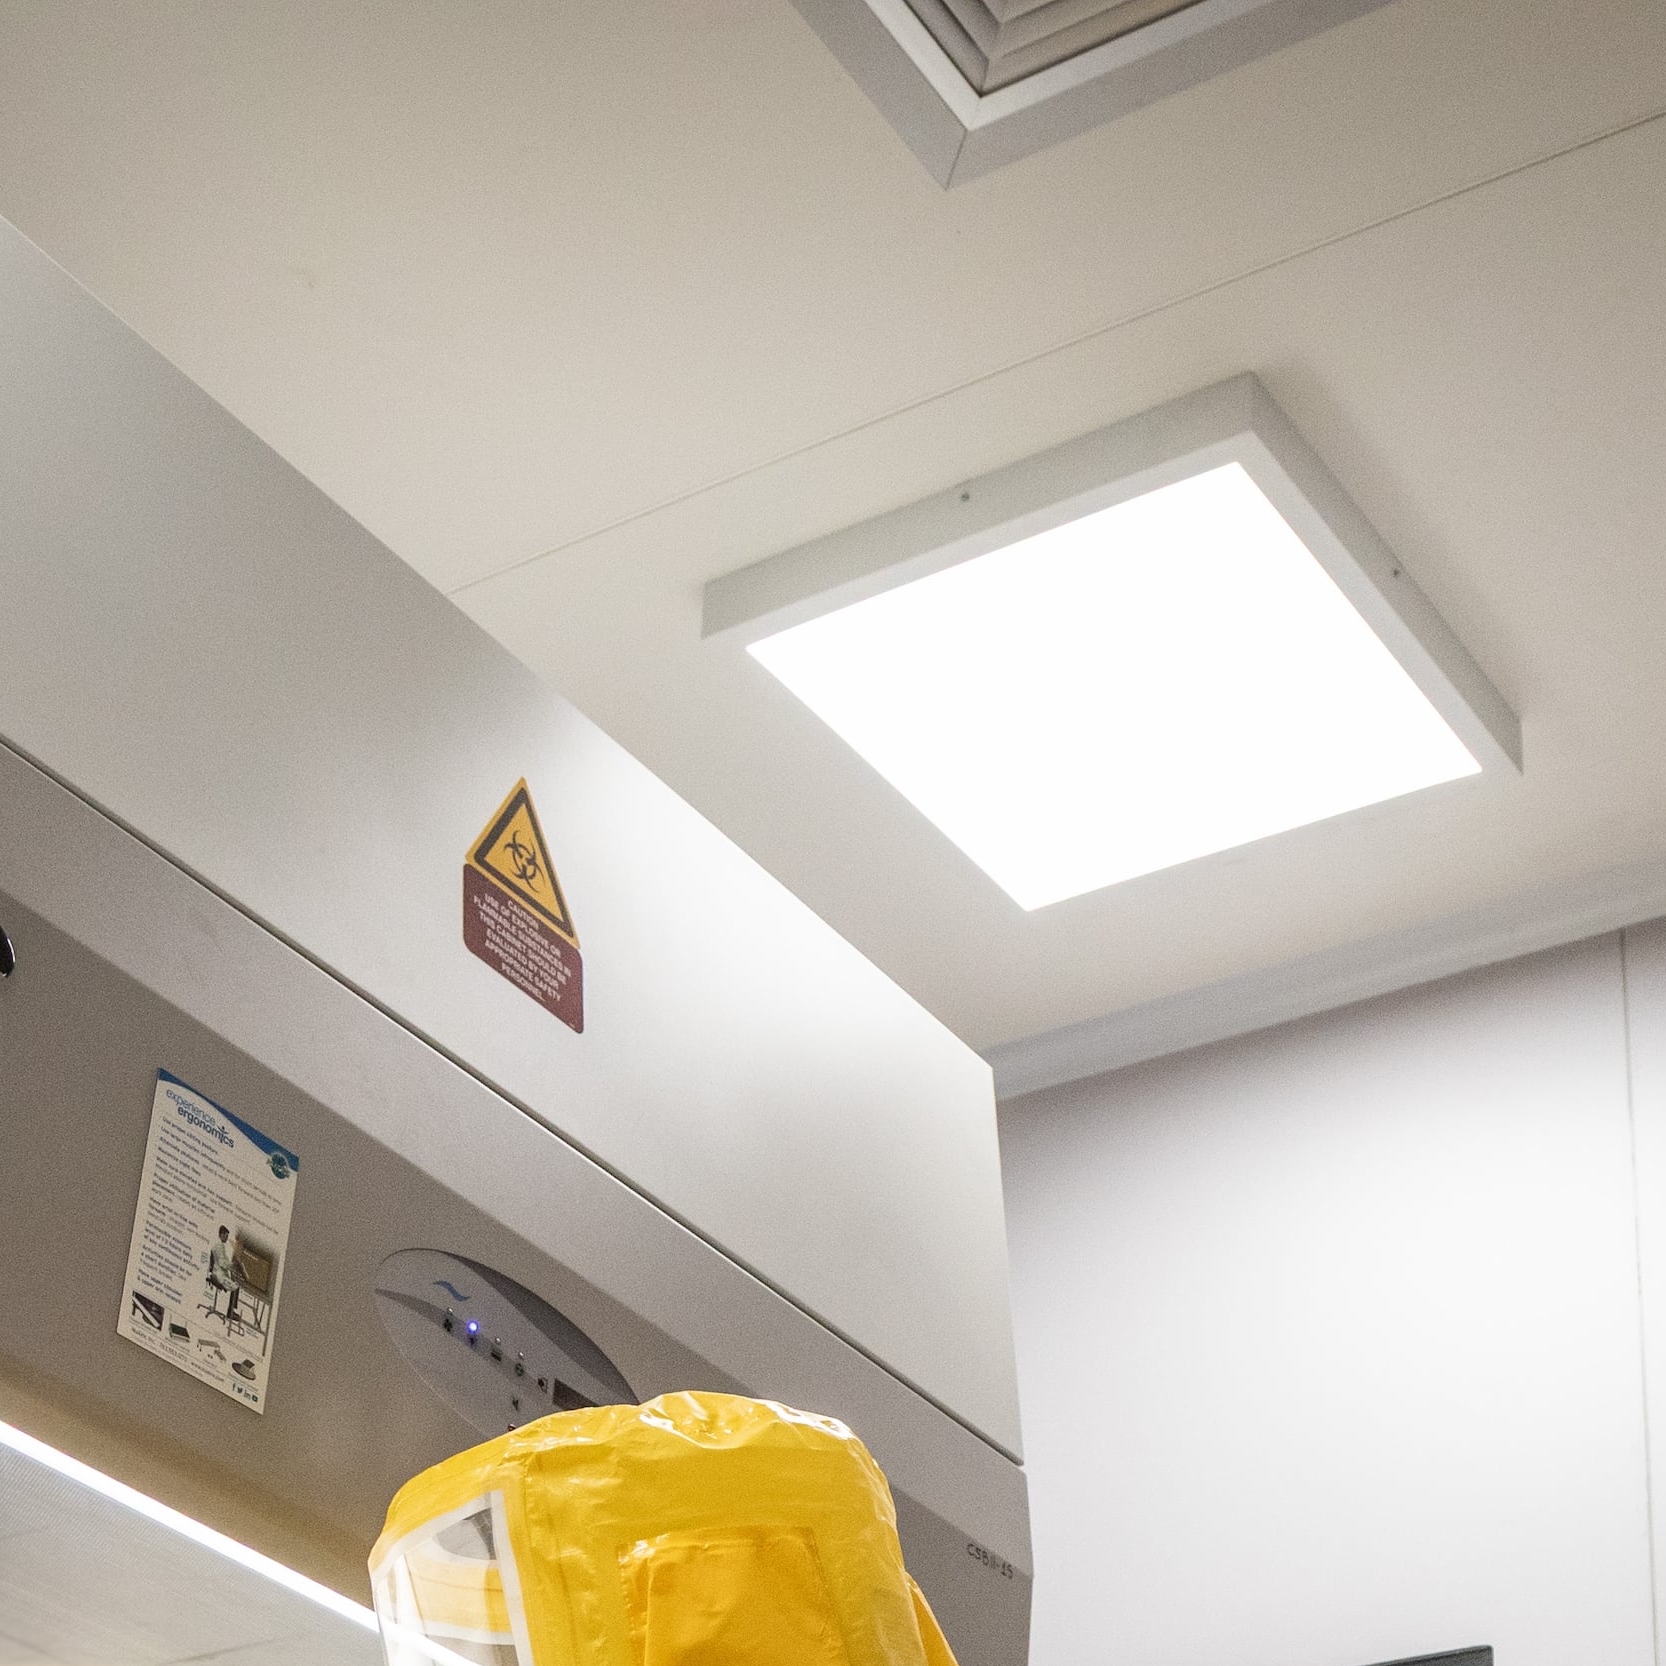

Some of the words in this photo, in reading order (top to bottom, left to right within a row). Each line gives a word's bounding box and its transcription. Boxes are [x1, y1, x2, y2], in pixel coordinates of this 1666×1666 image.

[474, 894, 516, 935] FLAMMABLE
[517, 928, 563, 971] SUBSTANCES
[563, 964, 571, 977] IN
[484, 892, 499, 910] USE
[500, 904, 510, 919] OF
[511, 913, 548, 949] EXPLOSIVE
[550, 943, 561, 958] OR
[507, 899, 538, 930] CAUTION
[480, 911, 495, 930] THIS
[496, 923, 526, 954] CABINET
[527, 947, 555, 977] SHOULD
[556, 970, 566, 985] BE
[485, 937, 533, 982] APPROPRIATE
[534, 975, 560, 1003] SAFETY
[486, 927, 527, 966] EVALUATED
[528, 959, 538, 974] BY
[539, 968, 558, 990] YOUR
[166, 1088, 216, 1126] experience
[177, 1106, 235, 1148] ergonomics
